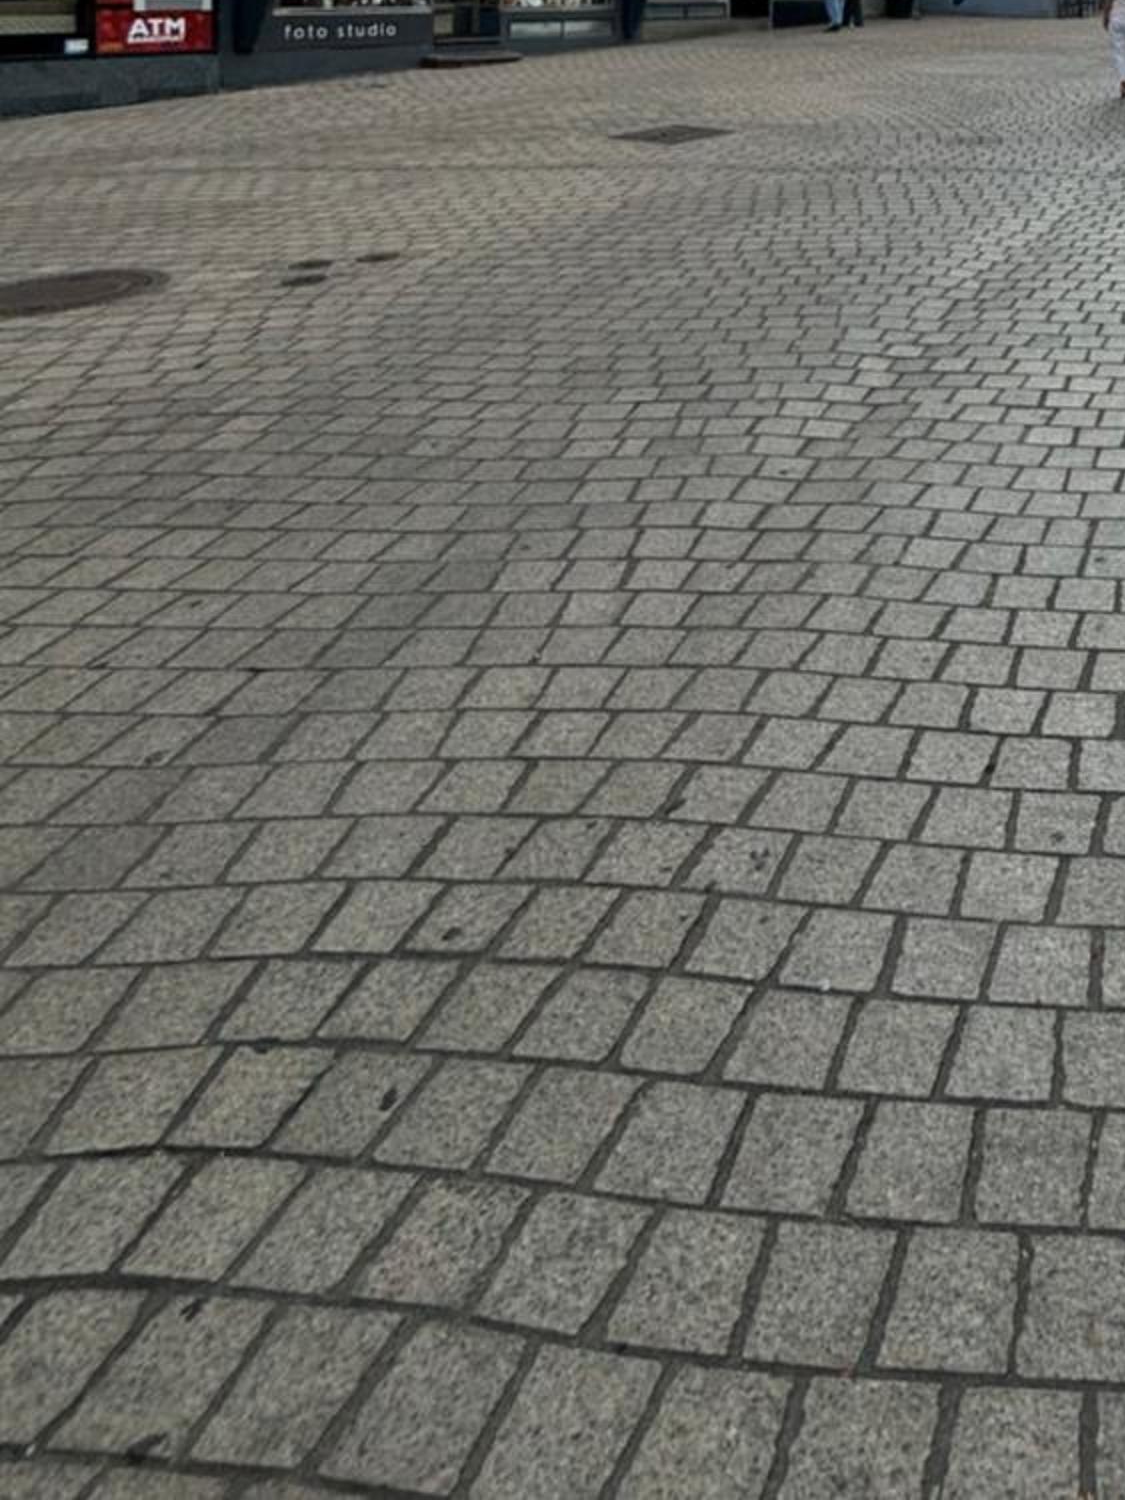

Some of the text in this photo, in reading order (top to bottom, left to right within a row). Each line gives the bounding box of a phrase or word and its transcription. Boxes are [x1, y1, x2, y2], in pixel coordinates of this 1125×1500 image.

[127, 16, 187, 45] ATM
[284, 22, 397, 40] foto studio
